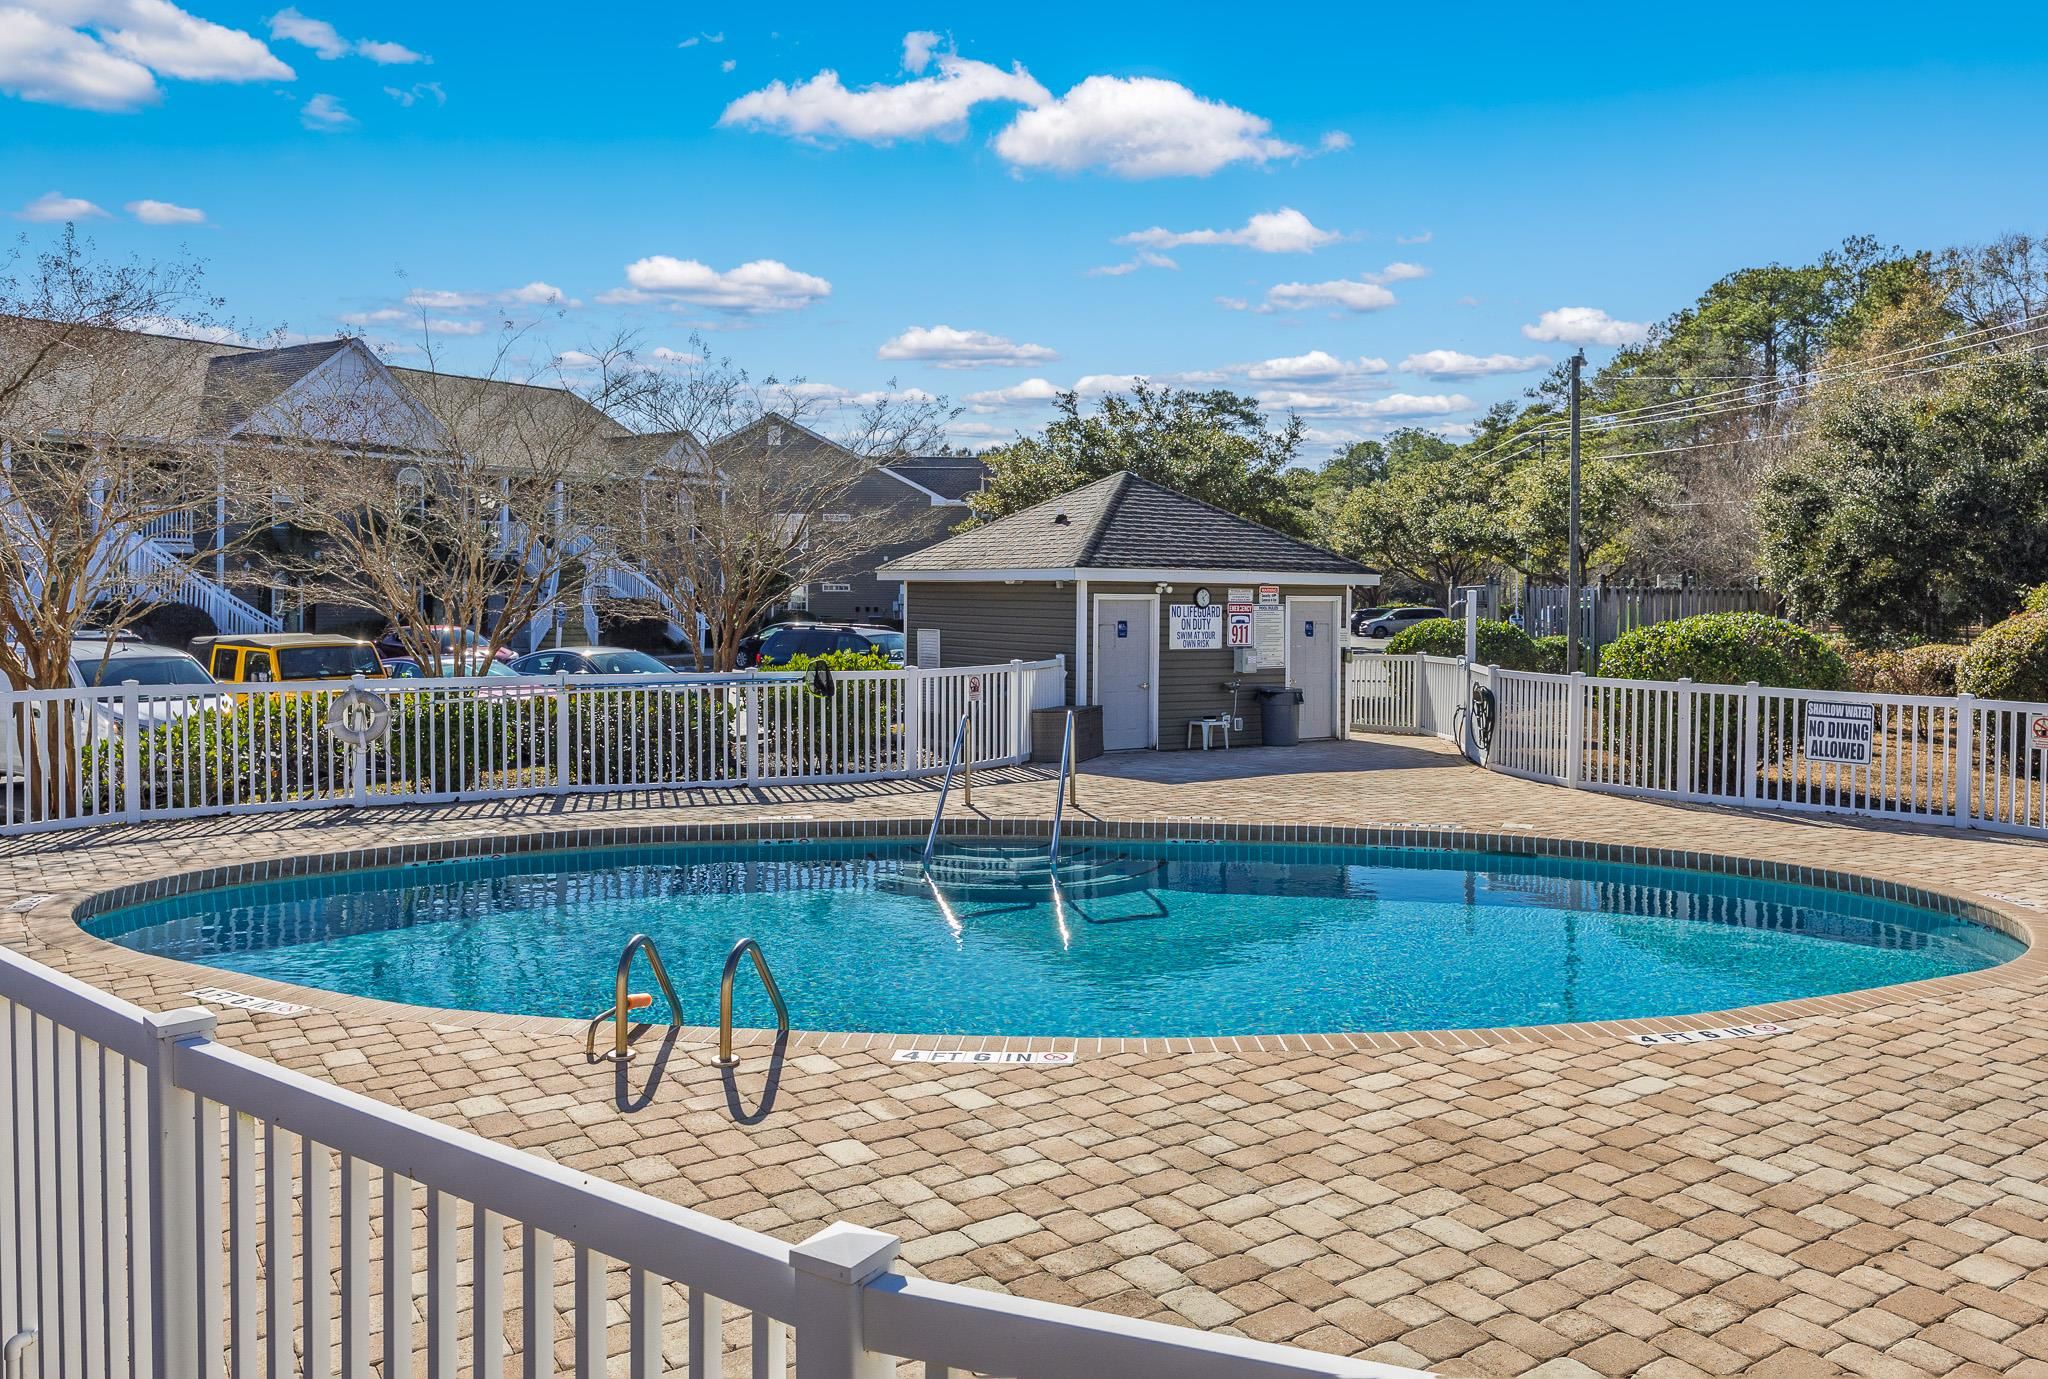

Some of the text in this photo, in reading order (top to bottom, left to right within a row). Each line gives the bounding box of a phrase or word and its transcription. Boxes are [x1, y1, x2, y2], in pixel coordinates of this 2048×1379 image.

[1171, 606, 1221, 617] NO LIFEGUARD
[1181, 619, 1211, 630] ON DUTY
[1232, 625, 1248, 643] 911
[1183, 640, 1209, 648] OWN RISK
[1808, 702, 1872, 719] SHALLOW WATER
[1809, 719, 1869, 741] NO DIVING
[1810, 739, 1865, 761] ALLOWED
[1641, 1035, 1658, 1043] 4
[1661, 1033, 1692, 1042] FT
[1723, 1027, 1756, 1036] IN
[902, 1051, 1032, 1062] 4 FT 6 IN
